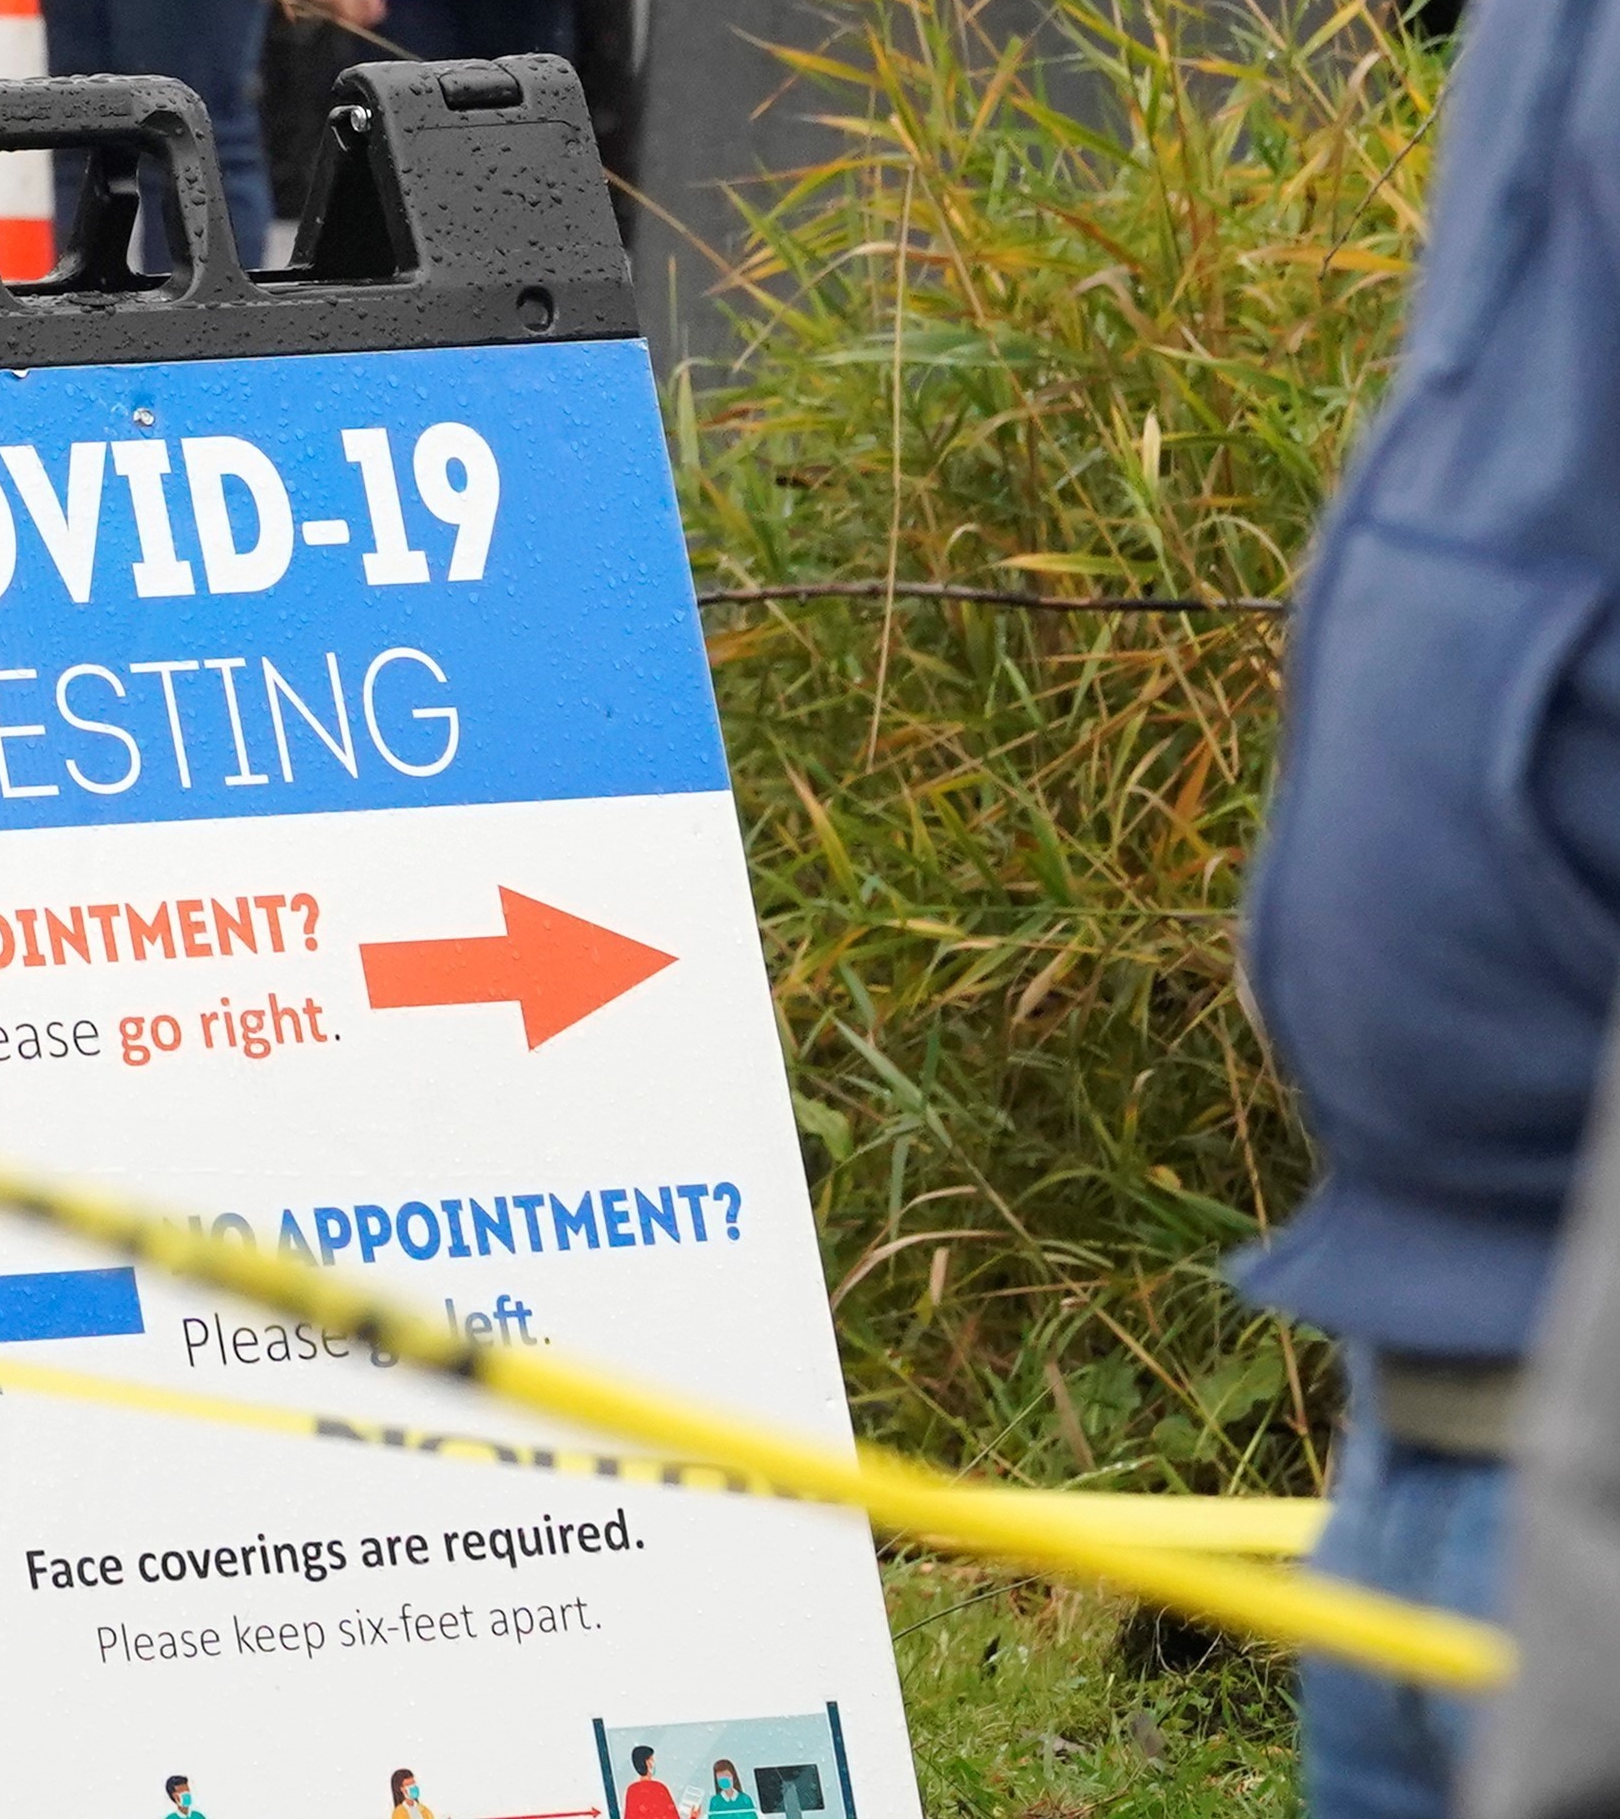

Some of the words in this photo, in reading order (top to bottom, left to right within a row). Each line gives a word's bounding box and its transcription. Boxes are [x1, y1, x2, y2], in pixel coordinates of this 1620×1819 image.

[118, 1014, 183, 1067] go
[200, 993, 343, 1060] right.
[274, 1181, 742, 1266] APPOINTMENT?
[180, 1312, 351, 1368] Please
[25, 1549, 124, 1590] Face
[138, 1533, 348, 1583] coverings
[360, 1534, 431, 1568] are
[443, 1507, 646, 1569] required.
[96, 1622, 222, 1664] Please
[233, 1614, 326, 1660] keep
[338, 1602, 479, 1647] six-feet
[489, 1596, 603, 1645] apart.
